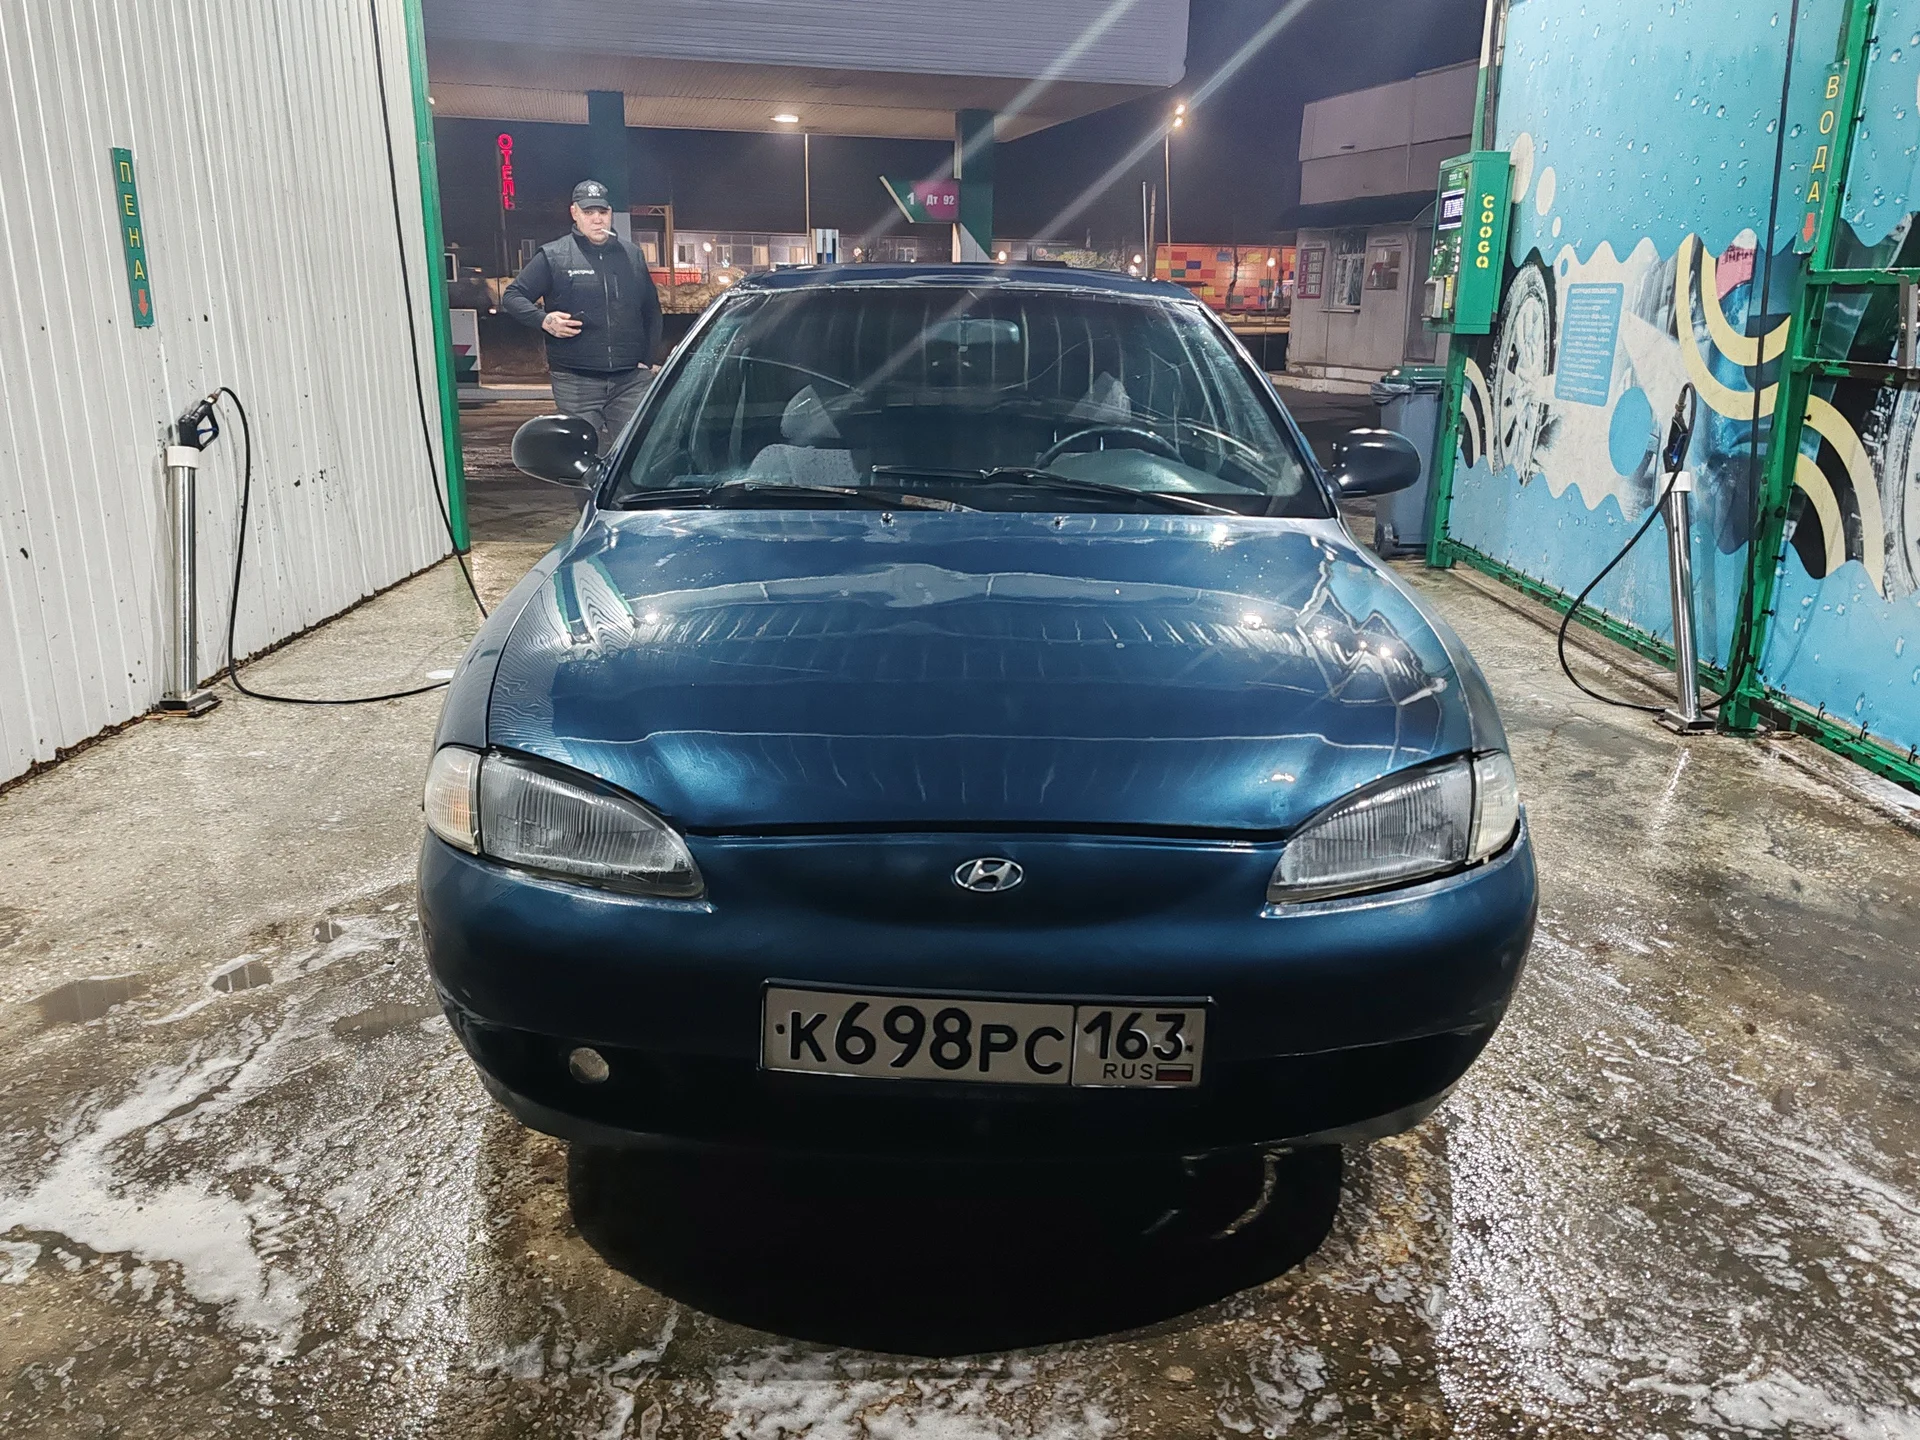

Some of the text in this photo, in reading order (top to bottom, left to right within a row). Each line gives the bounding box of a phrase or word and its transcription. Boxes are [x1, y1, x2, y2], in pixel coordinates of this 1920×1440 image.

[1806, 75, 1841, 204] ВОДА
[497, 133, 516, 211] ОТЕЛЬ
[906, 192, 915, 206] 1
[943, 195, 955, 206] 92
[119, 161, 146, 280] ПЕНА
[1083, 1010, 1186, 1061] 163
[1103, 1063, 1154, 1080] RUS
